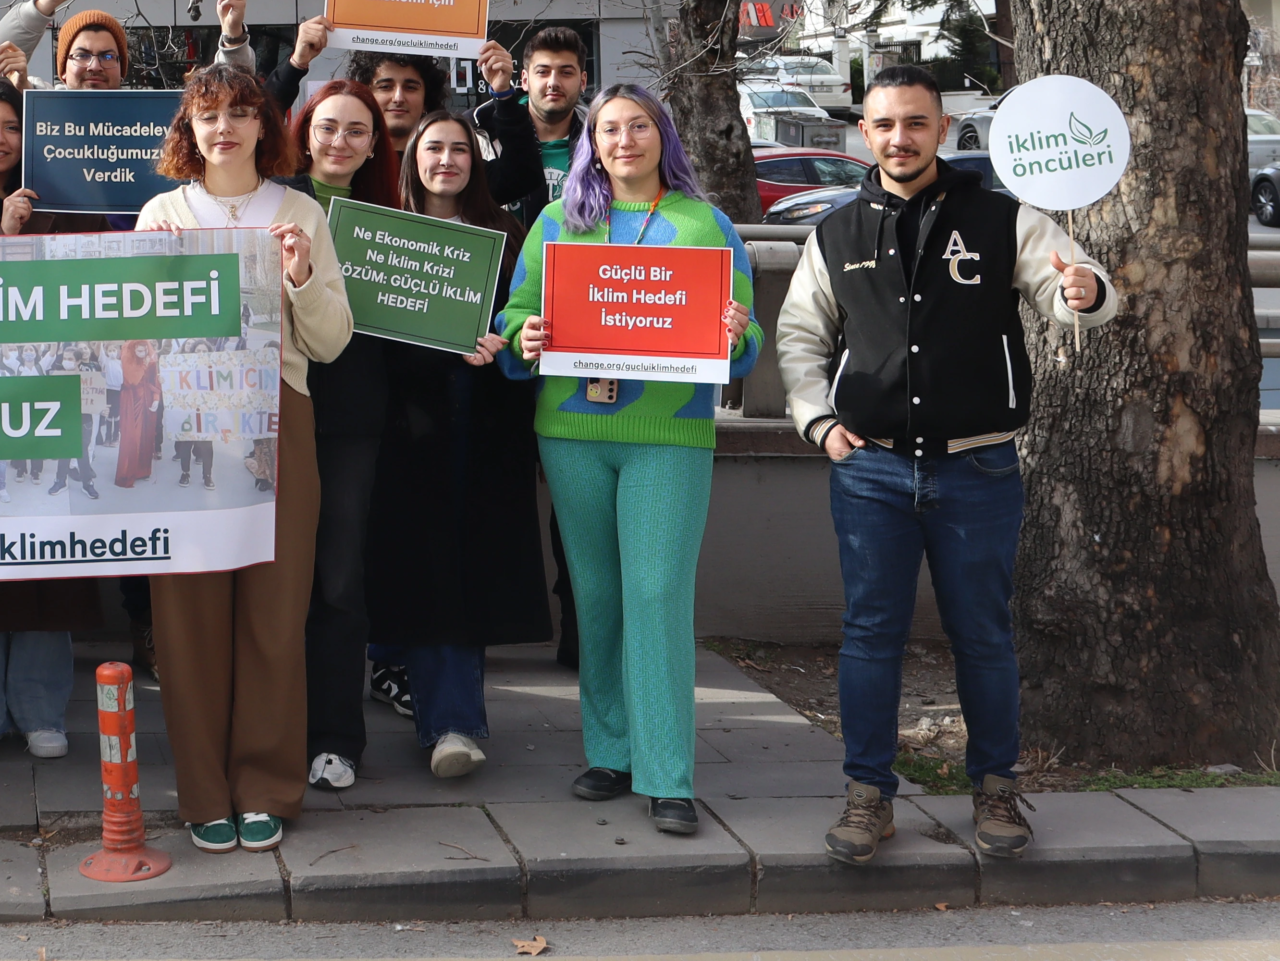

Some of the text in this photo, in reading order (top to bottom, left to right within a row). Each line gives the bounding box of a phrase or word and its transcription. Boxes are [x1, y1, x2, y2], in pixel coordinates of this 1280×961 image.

[351, 35, 459, 51] change.org/gucluiklimhedefi
[36, 121, 172, 139] Biz Bu Mücadeley
[1007, 130, 1068, 155] iklim
[1012, 144, 1114, 178] öncüleri
[82, 167, 135, 182] Verdik
[353, 226, 472, 262] Ne Ekonomik Kriz
[366, 249, 455, 279] Ne İklim Krizi
[598, 264, 673, 283] Güçlü Bir
[339, 261, 482, 305] ÖZÜM: GÜÇLÜ İKLİM
[59, 270, 220, 320] HEDEFİ
[377, 291, 430, 313] HEDEFİ
[588, 284, 686, 305] İklim Hedefi
[601, 308, 673, 330] İstiyoruz
[573, 359, 697, 374] change.org/gucluiklimhedefi
